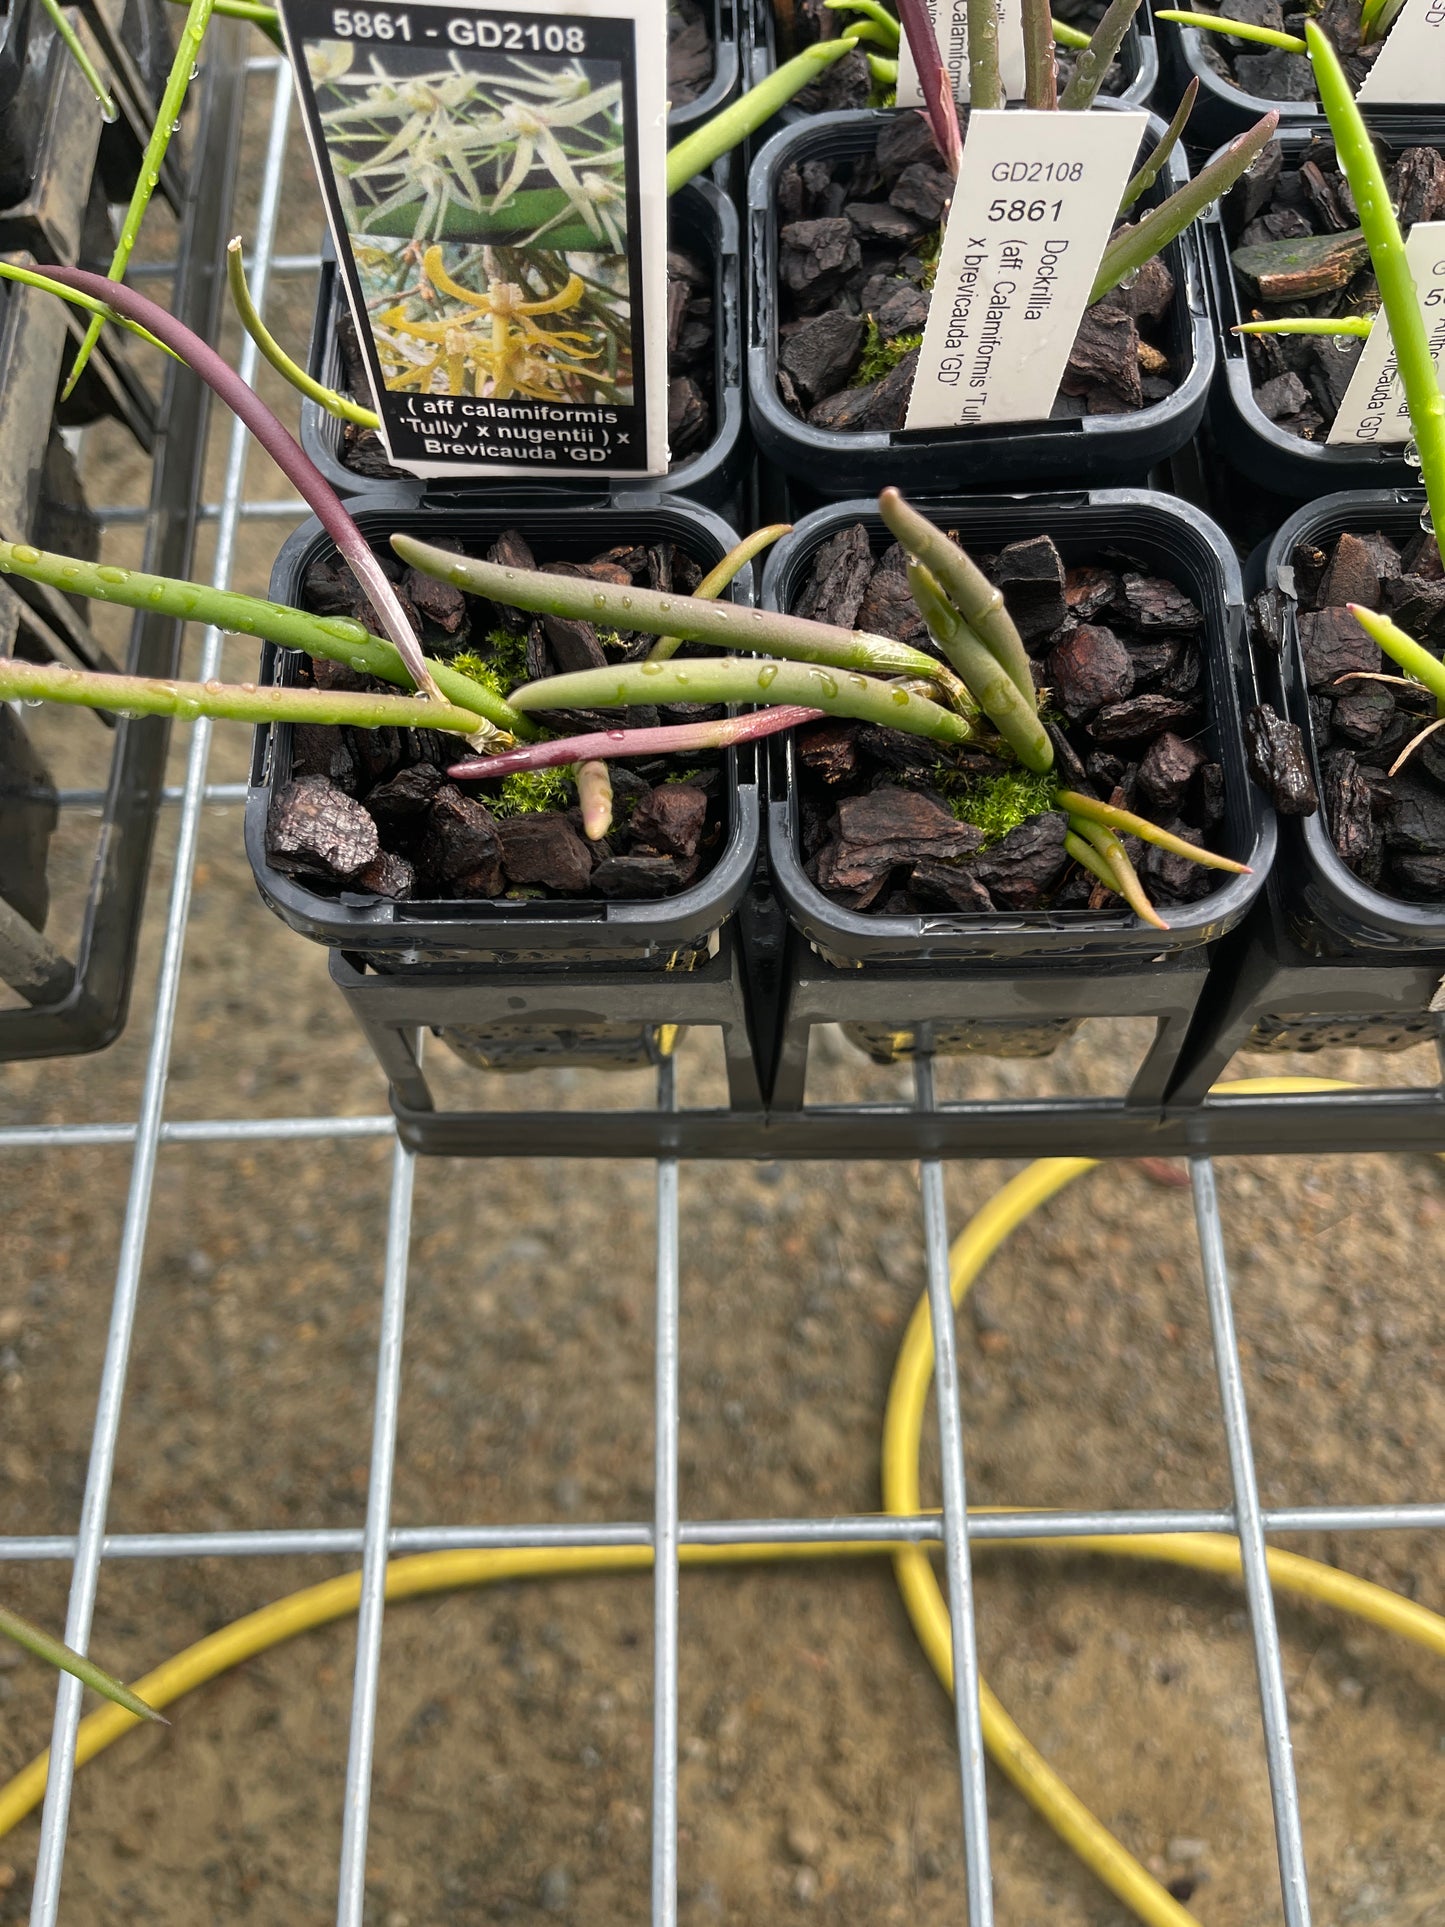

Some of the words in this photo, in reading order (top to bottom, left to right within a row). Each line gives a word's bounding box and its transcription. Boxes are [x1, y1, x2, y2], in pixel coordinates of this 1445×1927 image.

[332, 8, 412, 41] 5861
[425, 29, 438, 37] -
[447, 18, 585, 53] GD2108
[991, 162, 1083, 182] GD2108
[988, 199, 1063, 222] 5861
[967, 238, 987, 248] x
[998, 239, 1028, 275] (aff.
[1024, 240, 1069, 320] Dockrillia
[944, 255, 988, 349] brevicauda
[969, 281, 1017, 388] Calamiformis
[938, 353, 965, 387] 'GD'
[423, 399, 455, 416] aff
[461, 403, 618, 424] calamiformis
[400, 417, 469, 439] 'Tully'
[476, 424, 491, 438] x
[497, 426, 594, 445] nugentii
[616, 432, 630, 445] x
[424, 439, 557, 461] Brevicauda
[564, 447, 612, 463] 'GD'
